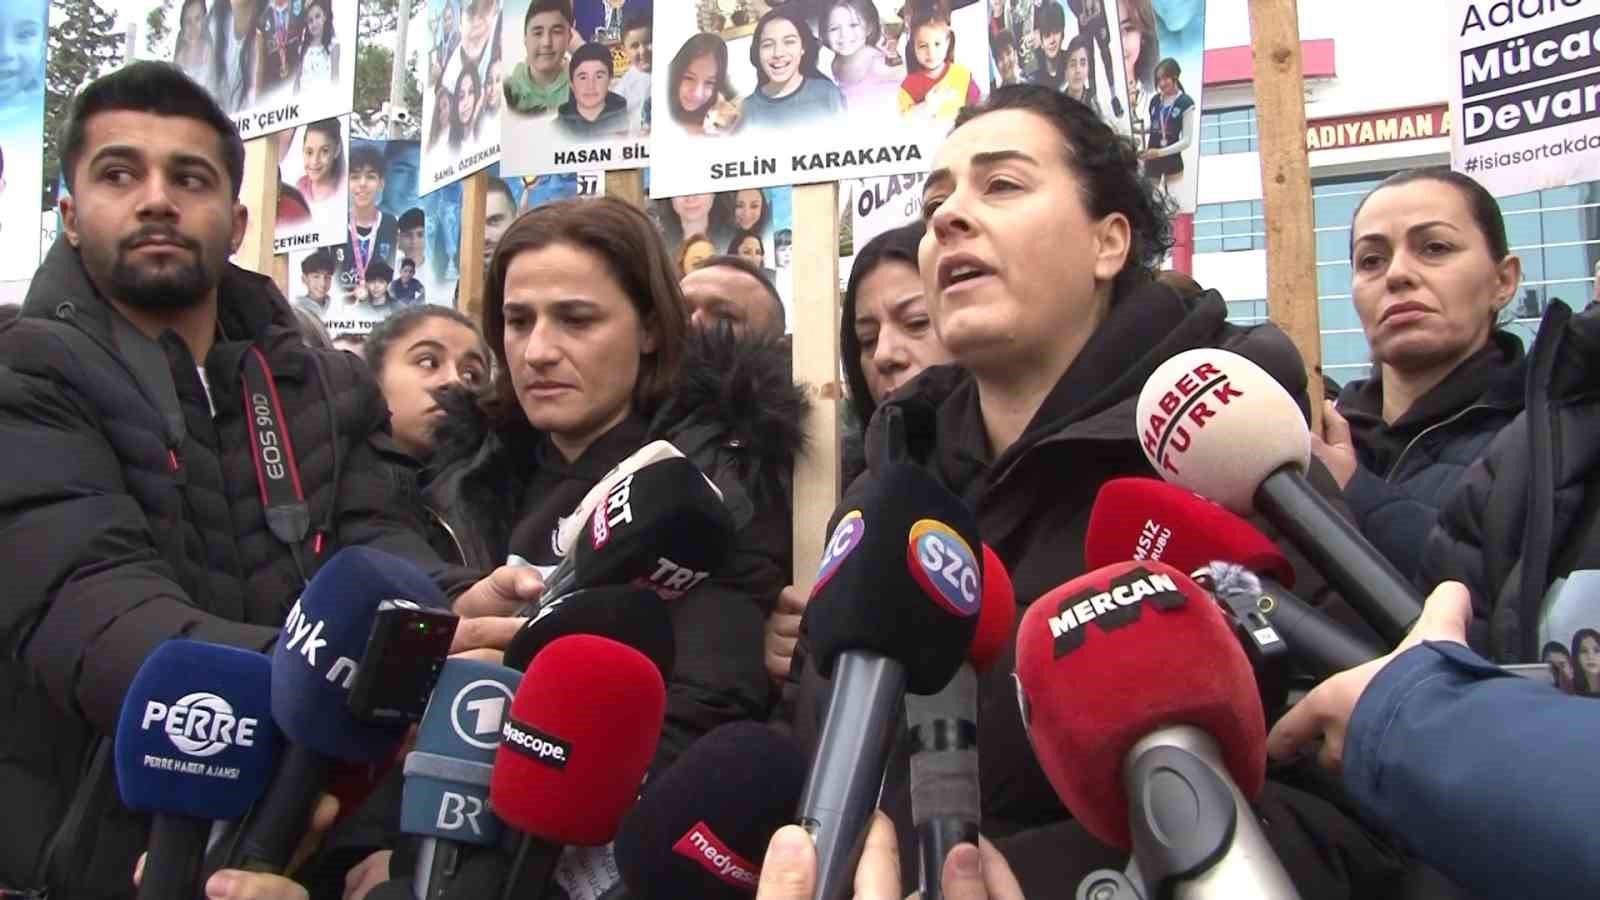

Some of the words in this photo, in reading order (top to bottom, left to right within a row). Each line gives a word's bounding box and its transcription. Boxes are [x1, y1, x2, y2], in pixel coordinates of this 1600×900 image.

[1462, 25, 1600, 87] Müca
[1306, 113, 1432, 148] ADIYAMAN
[554, 148, 611, 165] HASAN
[710, 156, 776, 180] SELİN
[791, 144, 922, 171] KARAKAYA
[252, 393, 273, 426] 90D
[1144, 363, 1221, 458] HABER
[260, 431, 285, 480] EOS
[921, 535, 977, 603] SZC
[1048, 574, 1177, 638] MERCAN
[141, 701, 258, 747] PERRE
